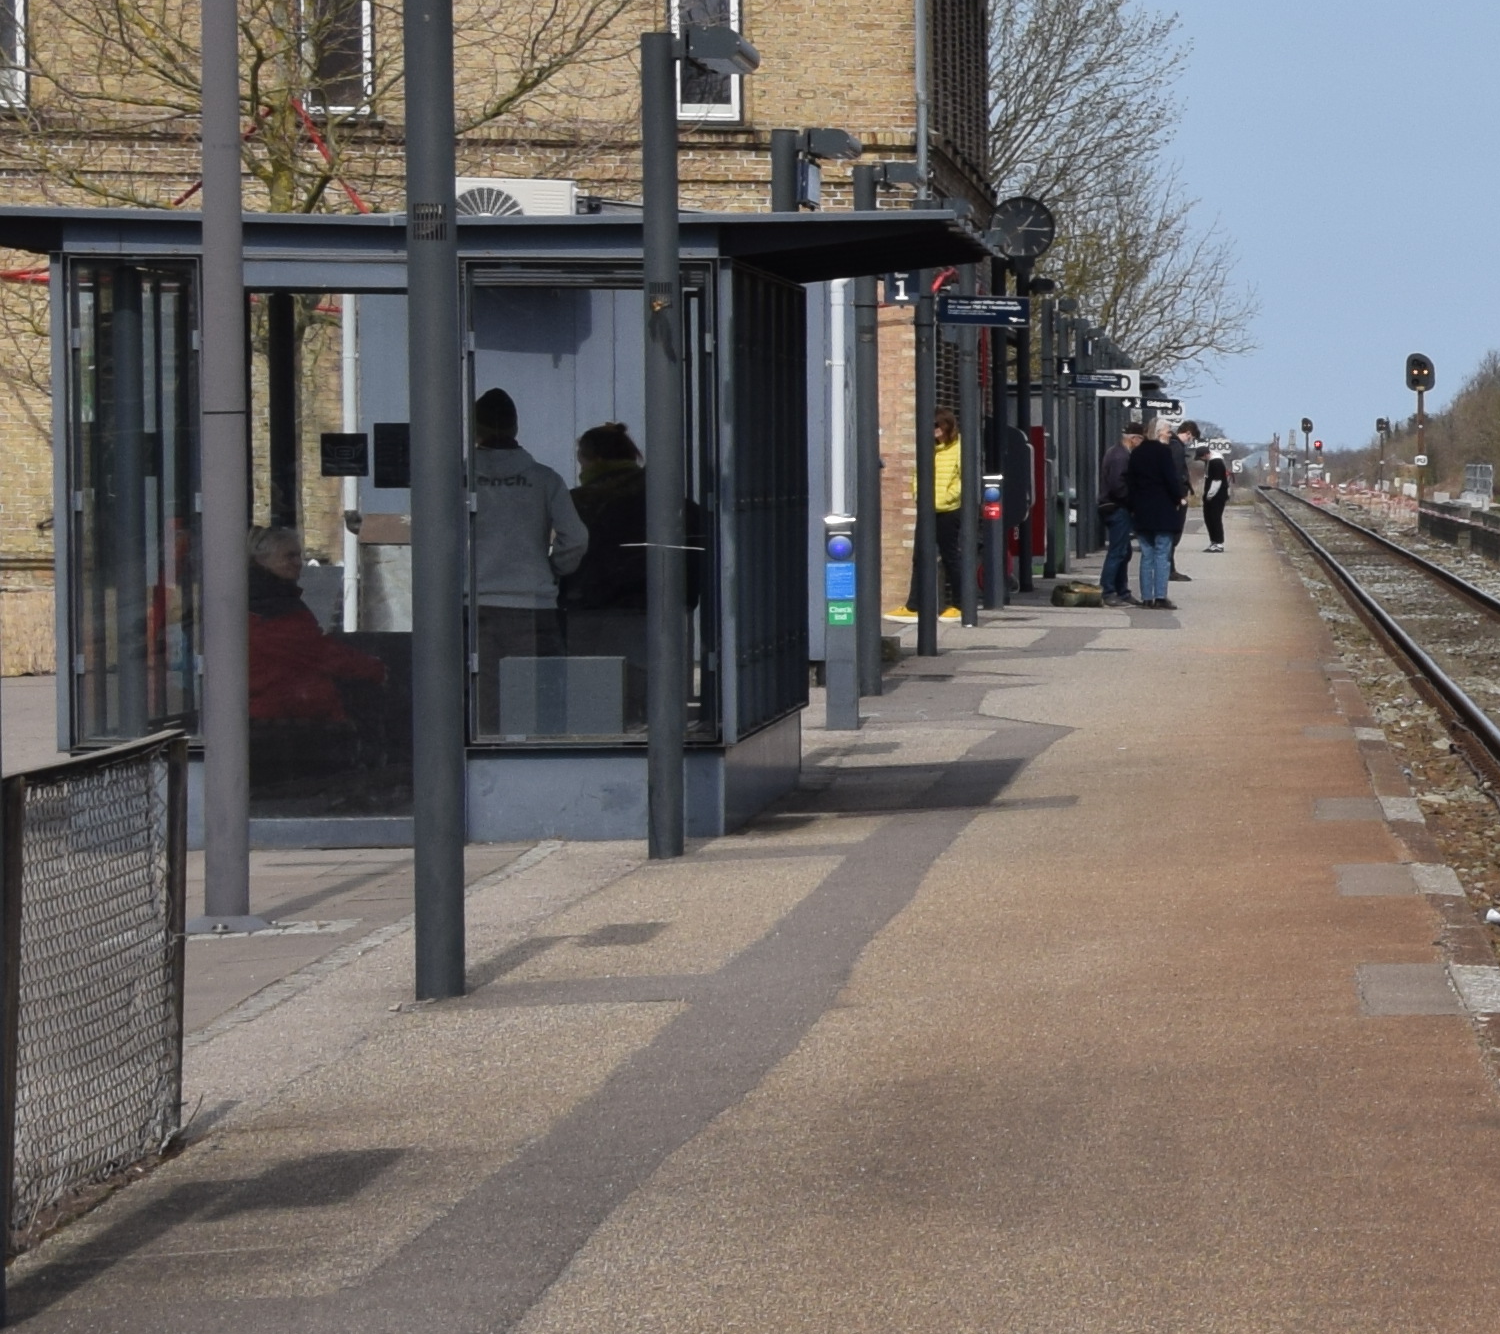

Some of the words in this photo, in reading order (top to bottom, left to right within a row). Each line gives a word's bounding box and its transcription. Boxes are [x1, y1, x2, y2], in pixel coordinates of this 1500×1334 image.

[895, 280, 909, 300] 1
[1062, 363, 1070, 373] 1
[1209, 442, 1231, 450] 300
[1234, 460, 1241, 472] S
